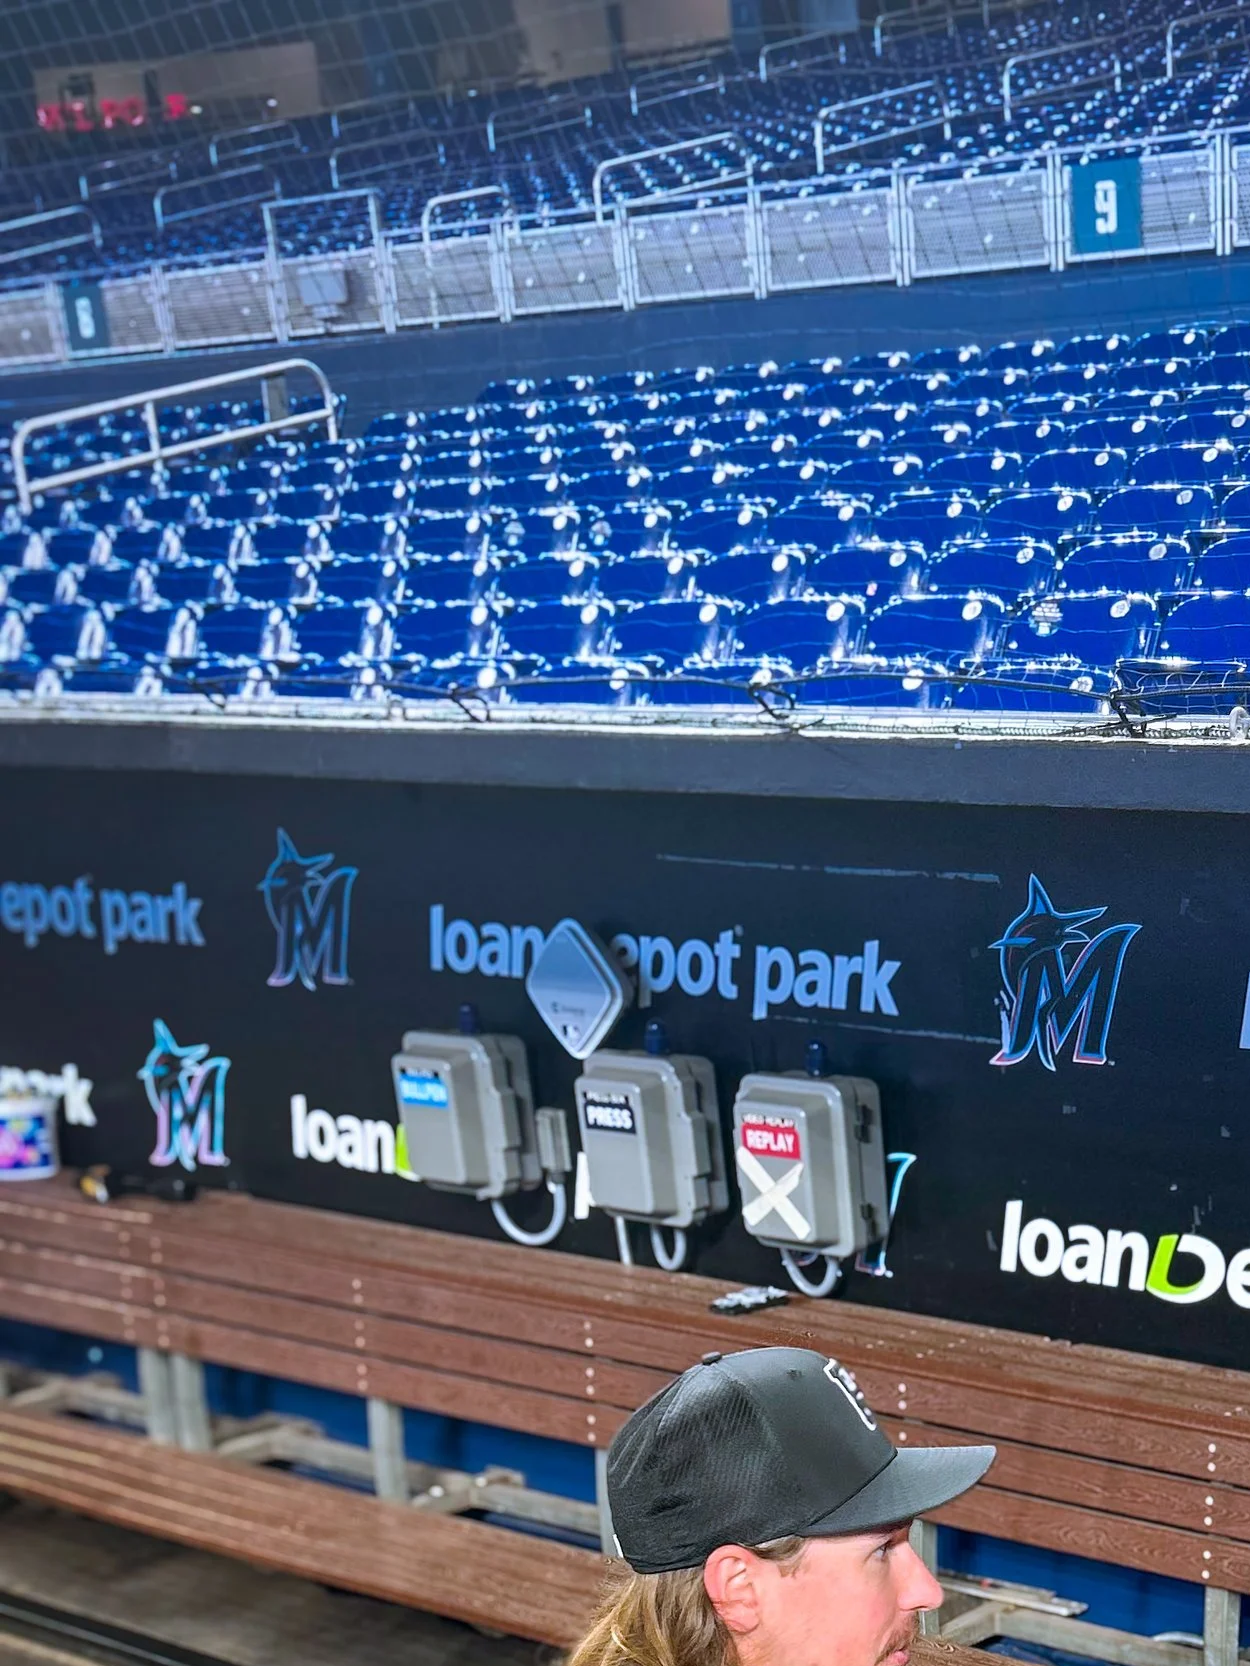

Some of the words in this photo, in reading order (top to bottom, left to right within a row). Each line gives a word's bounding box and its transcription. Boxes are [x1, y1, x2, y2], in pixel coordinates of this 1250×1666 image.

[1094, 179, 1118, 234] 9
[100, 881, 206, 955] park
[429, 903, 743, 1009] loanepot
[752, 939, 902, 1021] park
[586, 1105, 633, 1130] PRESS
[745, 1128, 795, 1153] REPLAY
